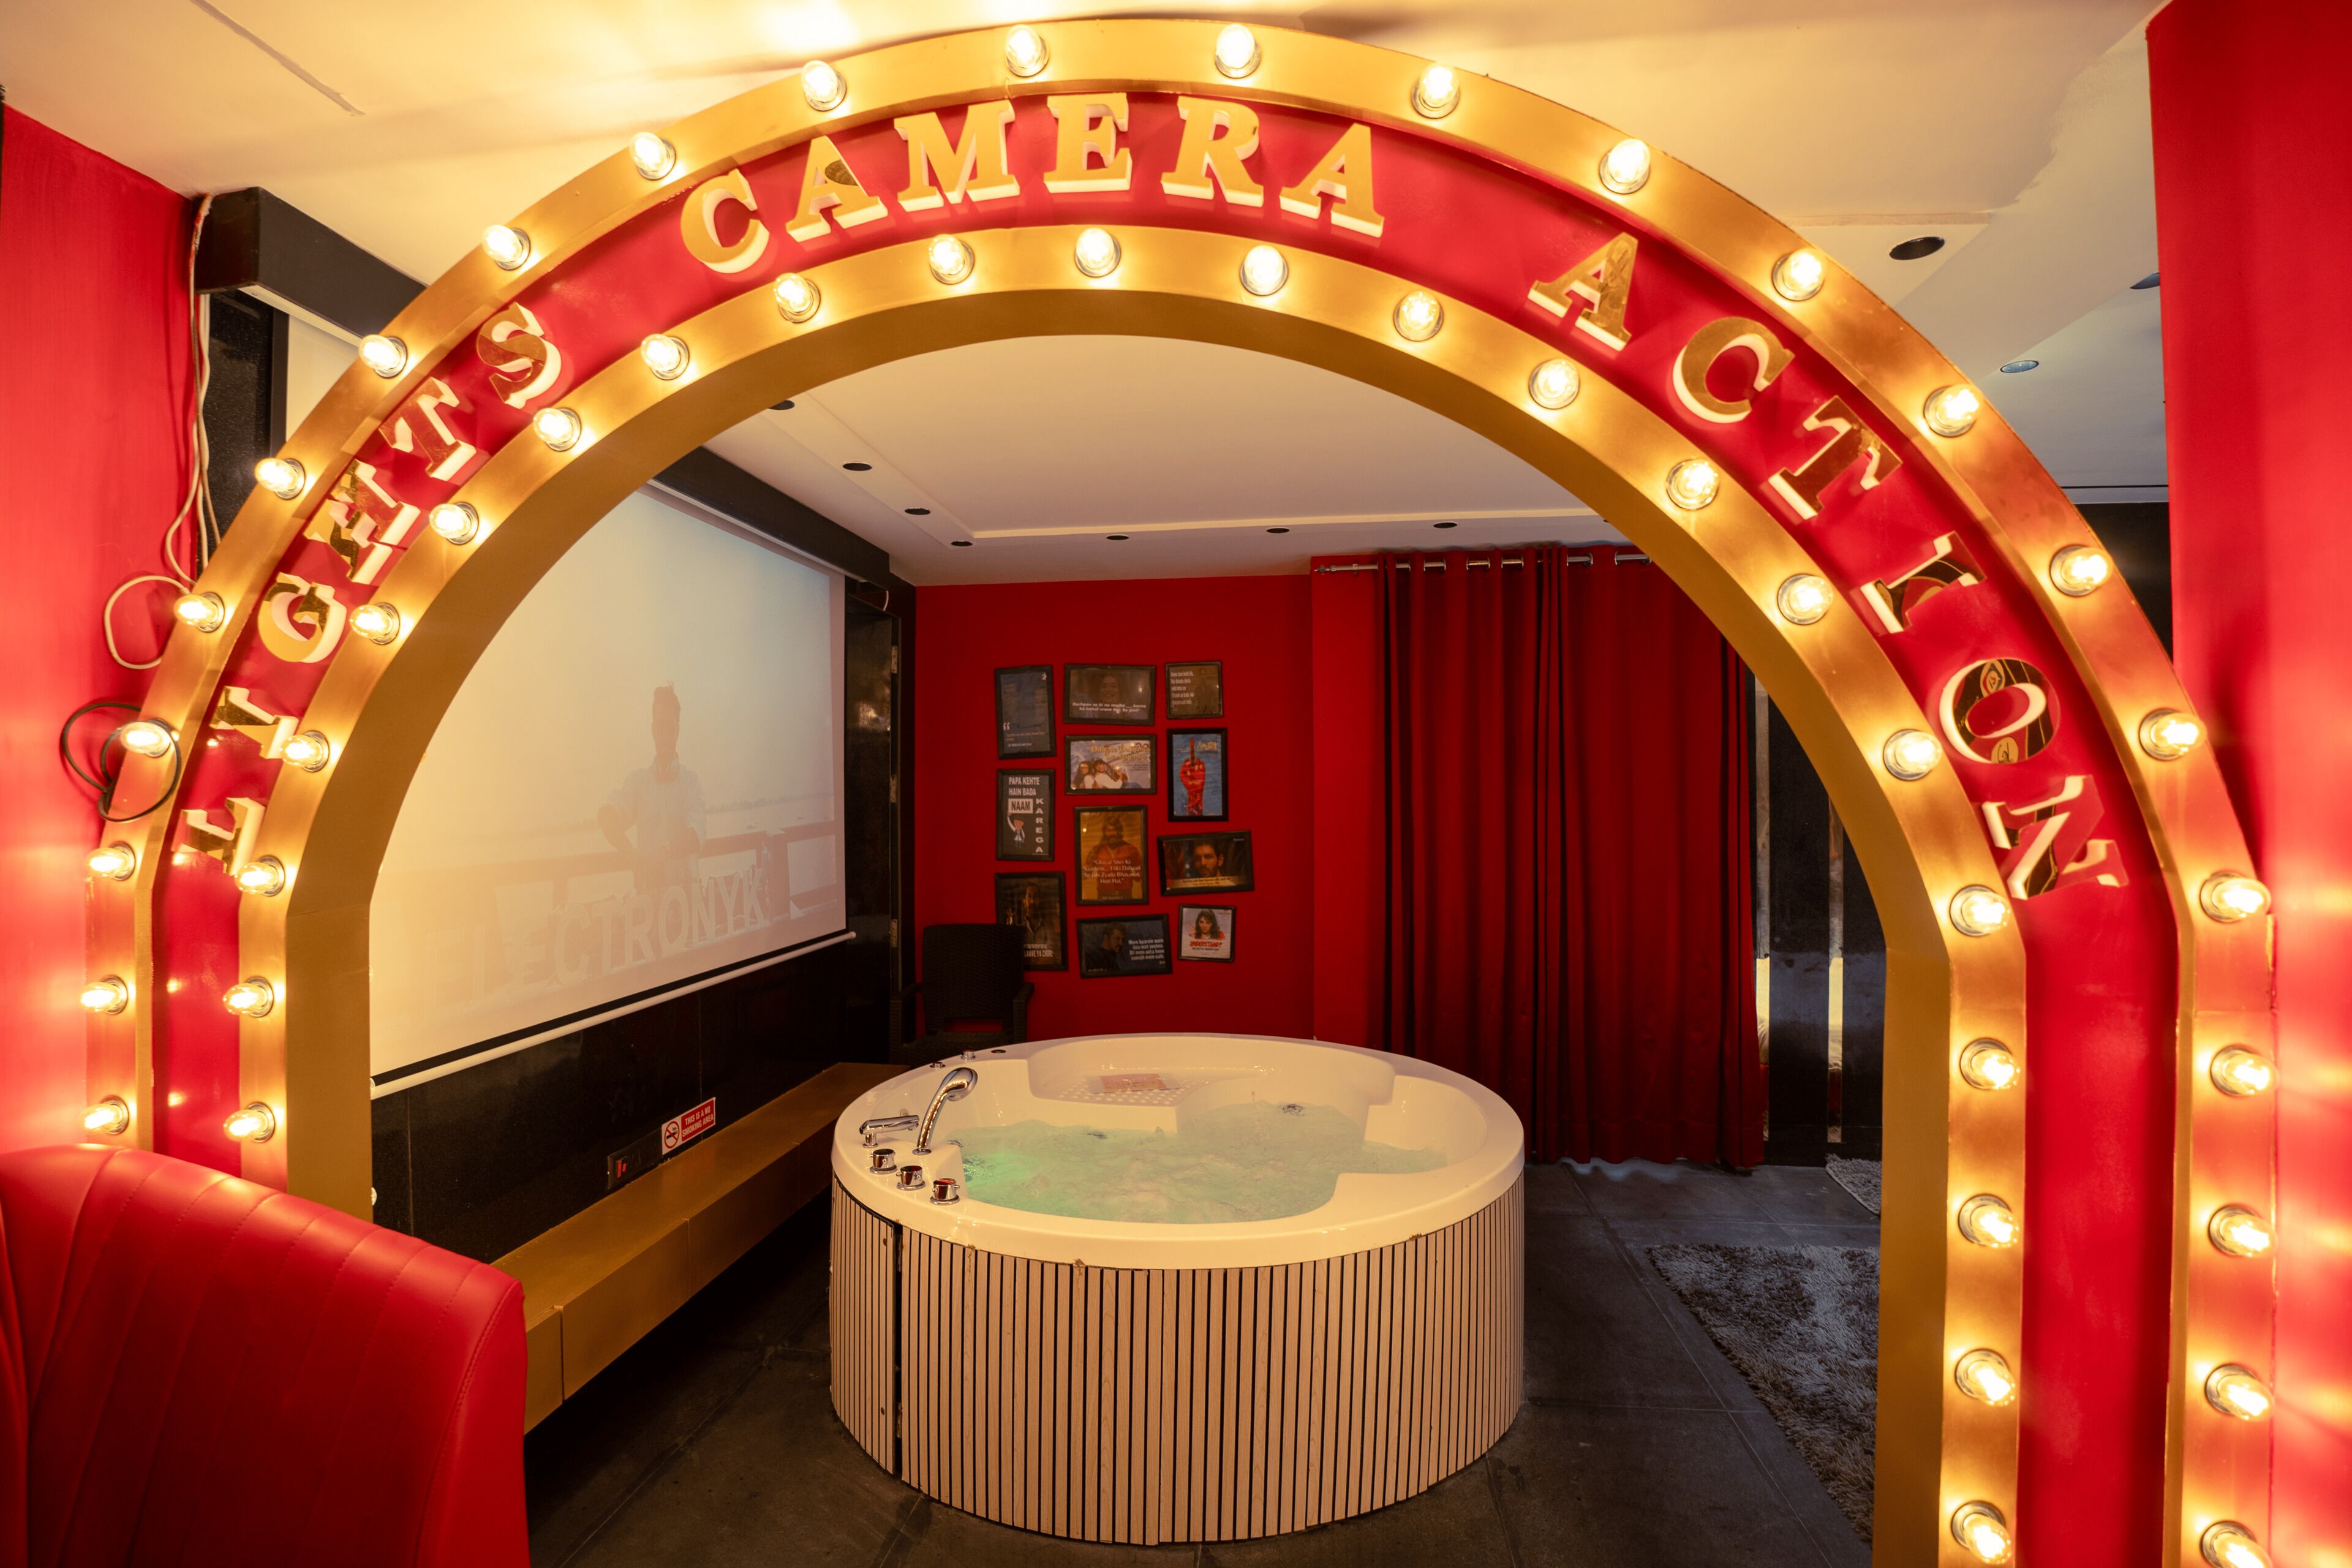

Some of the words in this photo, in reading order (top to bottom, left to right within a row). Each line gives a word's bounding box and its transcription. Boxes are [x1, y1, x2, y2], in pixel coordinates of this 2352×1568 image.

[172, 303, 562, 875] LIGHTS
[680, 92, 1385, 274] CAMERA
[1527, 233, 2128, 900] ACTION
[1022, 777, 1040, 785] KEHTE
[1011, 801, 1031, 811] NAAM
[1035, 798, 1044, 853] KAREGA
[682, 1120, 702, 1137] SMOKING
[703, 1114, 714, 1125] AREA
[685, 1115, 696, 1125] THIS
[695, 1112, 700, 1120] IS
[704, 1106, 711, 1115] NO
